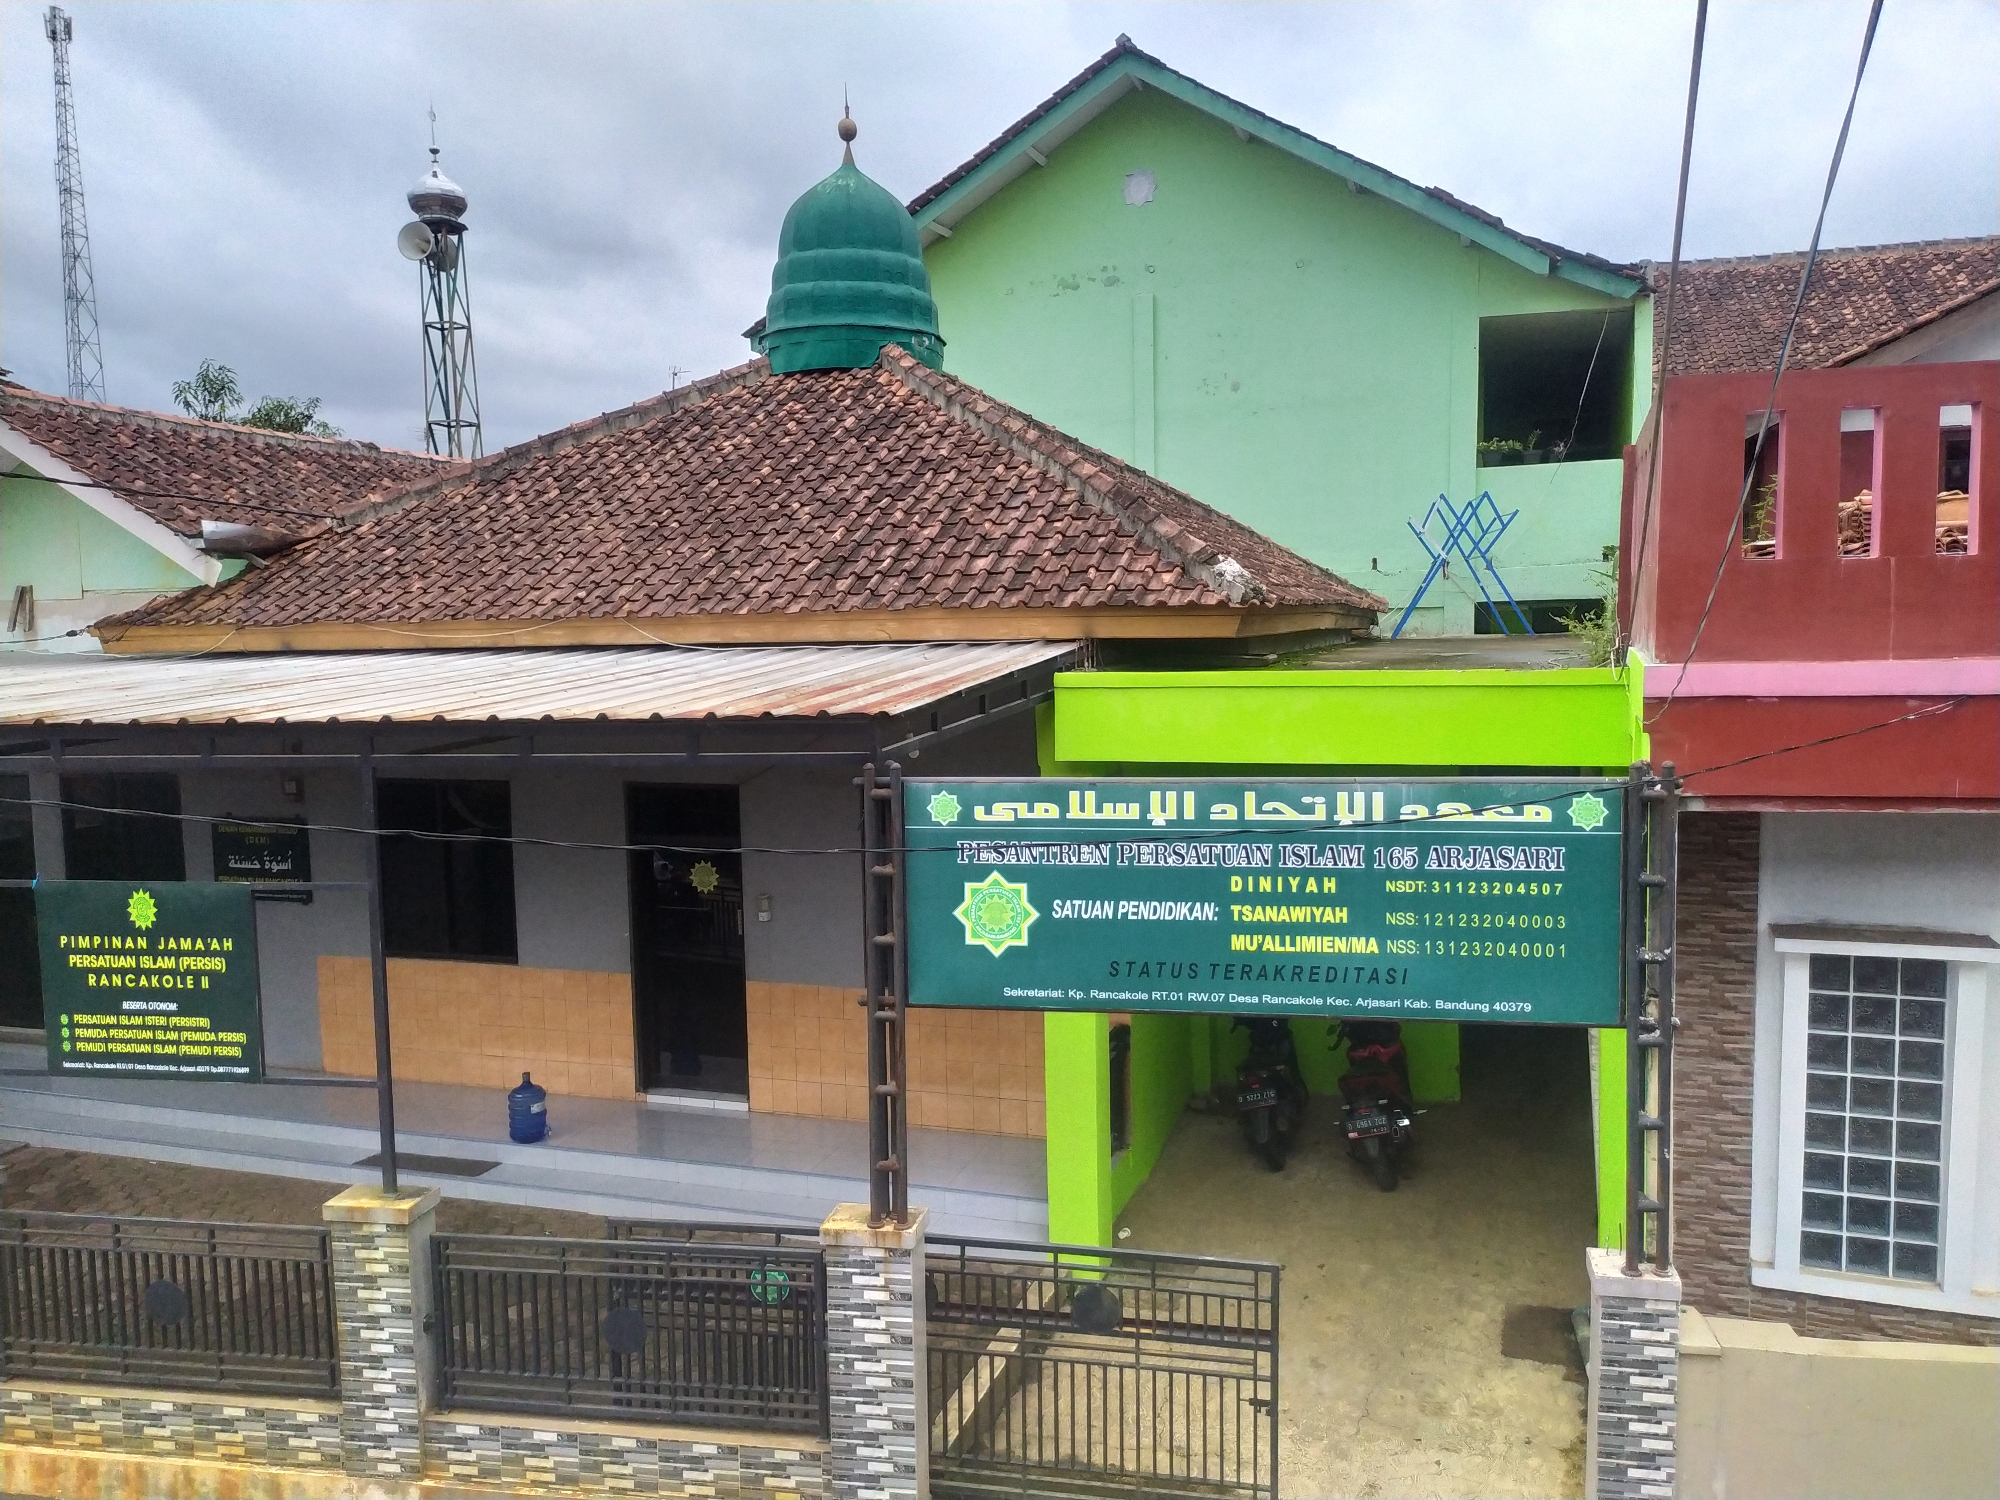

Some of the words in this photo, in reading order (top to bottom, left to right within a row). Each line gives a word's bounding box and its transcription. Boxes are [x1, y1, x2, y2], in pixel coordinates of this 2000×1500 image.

[1399, 802, 1552, 823] معهد
[957, 840, 1111, 866] PESANTREN
[1116, 842, 1272, 867] PERSATUAN
[1278, 844, 1365, 868] ISLAM
[1373, 845, 1418, 870] 165
[1424, 846, 1565, 872] ARJASARI
[1230, 875, 1337, 894] DINIYAH
[1385, 879, 1428, 893] NSDT:
[1431, 881, 1563, 896] 31123204507
[1052, 899, 1115, 920] SATUAN
[1117, 900, 1219, 921] PENDIDIKAN:
[1230, 905, 1348, 923] TSANAWIYAH
[1385, 912, 1419, 926] NSS:
[1423, 913, 1566, 929] 121232040003
[59, 935, 148, 949] PIMPINAN
[157, 937, 233, 951] JAMA'AH
[1386, 940, 1420, 954] NSS:
[1424, 941, 1566, 958] 131232040001
[69, 955, 137, 969] PERSATUAN
[139, 955, 176, 969] ISLAM
[179, 956, 226, 973] (PERSIS)
[1108, 960, 1199, 979] STATUS
[1210, 963, 1409, 985] TERAKREDITASI
[88, 974, 195, 989] RANCAKOLE
[201, 976, 210, 989] II
[122, 1001, 148, 1010] BESERTA
[1003, 987, 1065, 998] Sekretariat:
[1068, 989, 1087, 1000] Kp.
[1090, 989, 1149, 1000] Rancakole
[1151, 990, 1184, 1001] RT.01
[1187, 991, 1226, 1003] RW.07
[1228, 992, 1259, 1003] Desa
[1262, 993, 1324, 1006] Rancakole
[1326, 995, 1353, 1007] Kec.
[1355, 996, 1401, 1010] Arjasari
[1404, 998, 1432, 1009] Kab.
[1435, 999, 1489, 1013] Bandung
[1492, 1001, 1532, 1013] 40379
[73, 1014, 117, 1025] PERSATUAN
[119, 1015, 144, 1026] ISLAM
[145, 1015, 167, 1026] ISTERI
[169, 1016, 211, 1029] (PERSISTRI)
[75, 1028, 108, 1039] PEMUDA
[109, 1028, 154, 1040] PERSATUAN
[155, 1030, 179, 1041] ISLAM
[180, 1030, 217, 1042] (PEMUDA
[218, 1031, 247, 1044] PERSIS)
[76, 1041, 106, 1052] PEMUDI
[107, 1042, 152, 1054] PERSATUAN
[153, 1043, 178, 1055] ISLAM
[178, 1044, 212, 1056] (PEMUDI
[213, 1045, 242, 1058] PERSIS)
